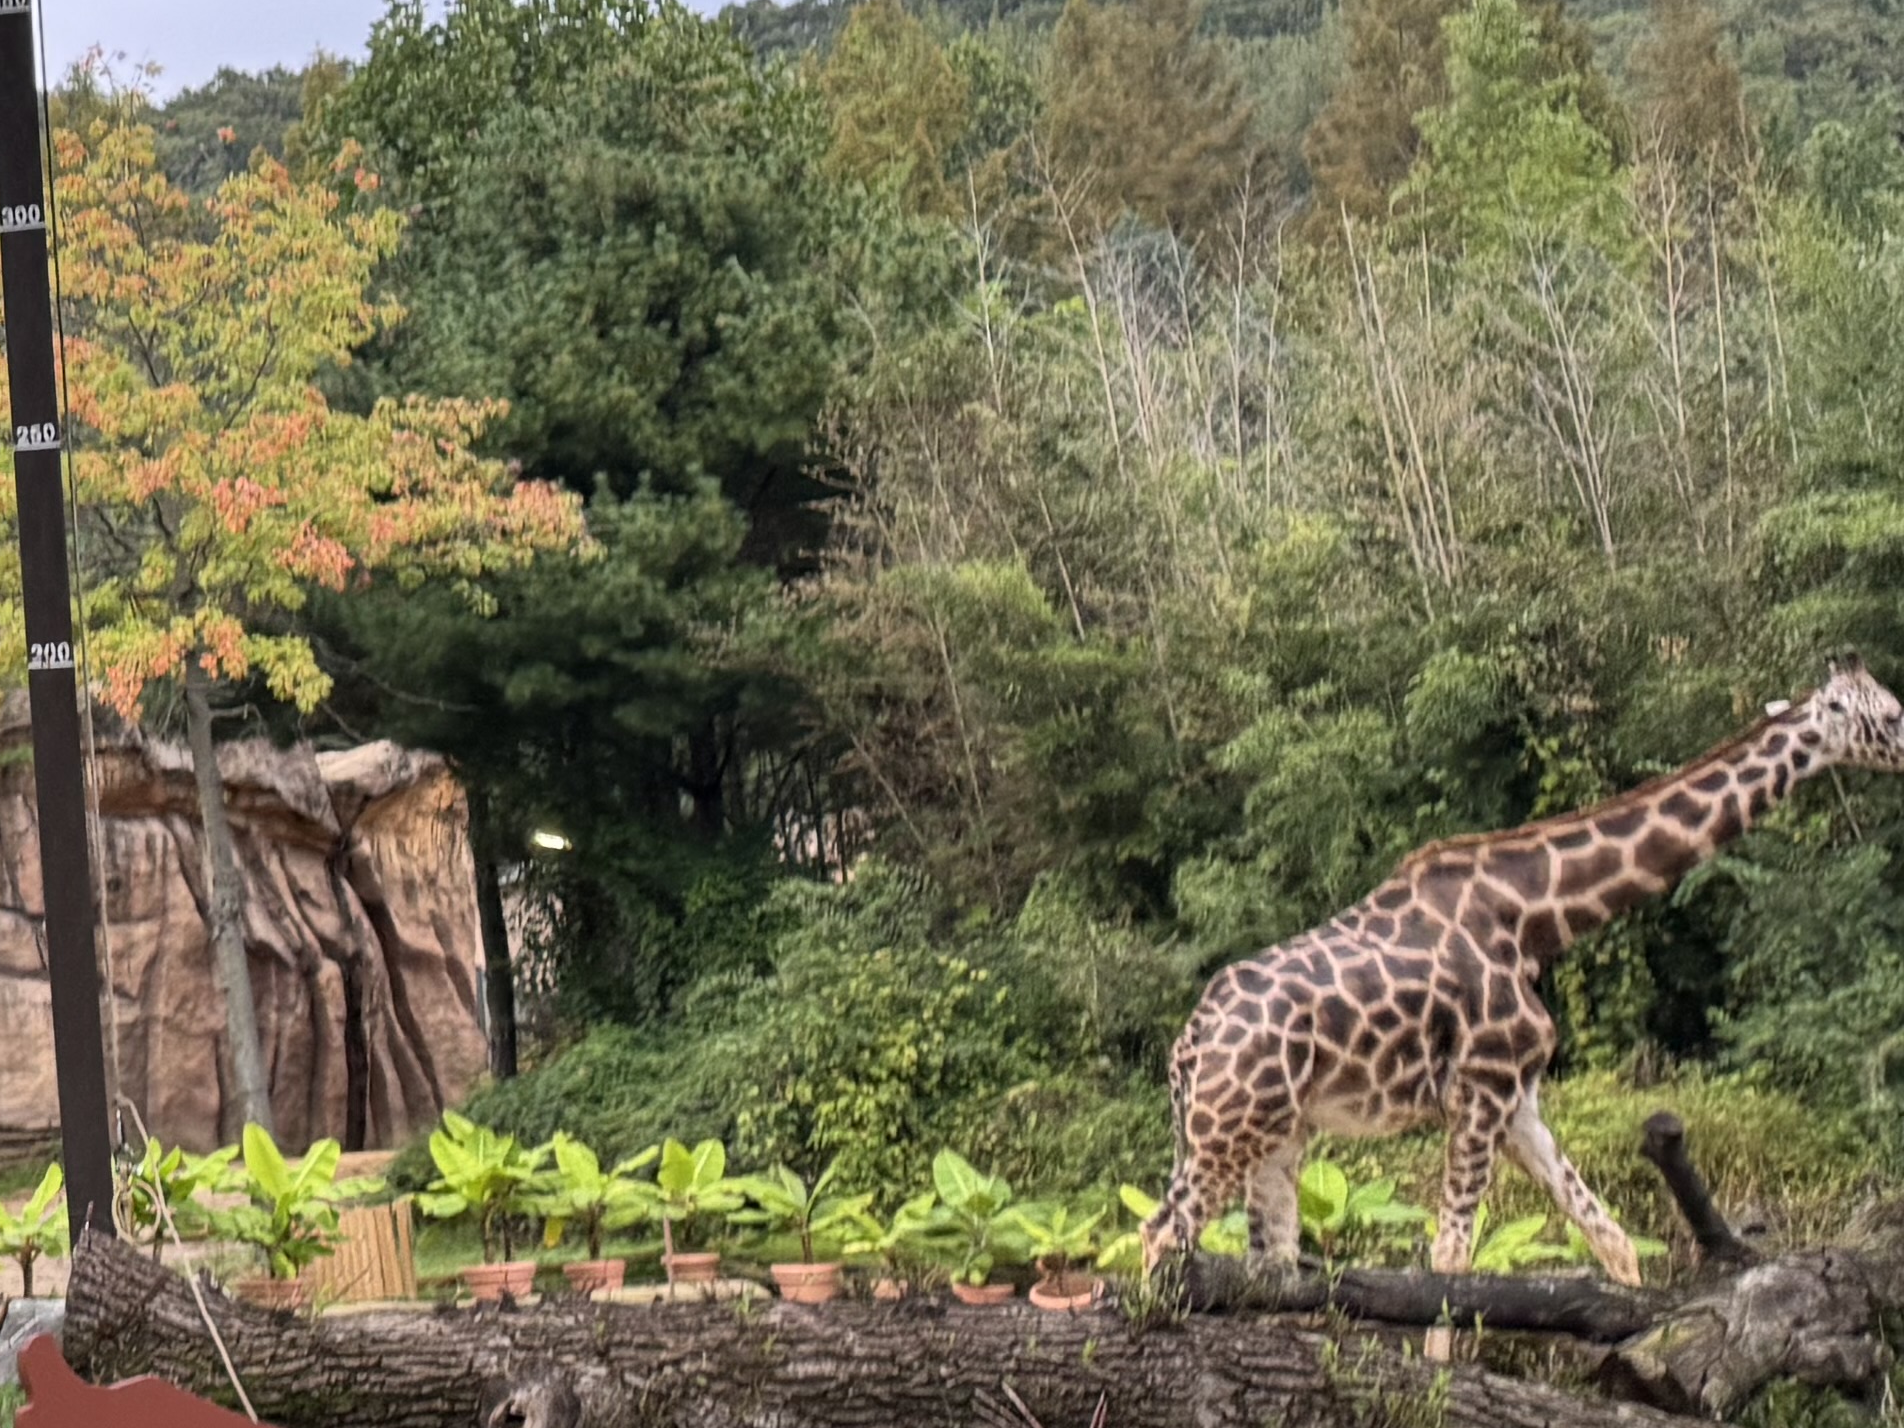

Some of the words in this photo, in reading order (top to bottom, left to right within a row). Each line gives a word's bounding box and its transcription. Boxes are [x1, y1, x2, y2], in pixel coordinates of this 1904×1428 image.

[1, 203, 41, 226] 300
[16, 422, 56, 444] 250
[30, 641, 71, 663] 200
